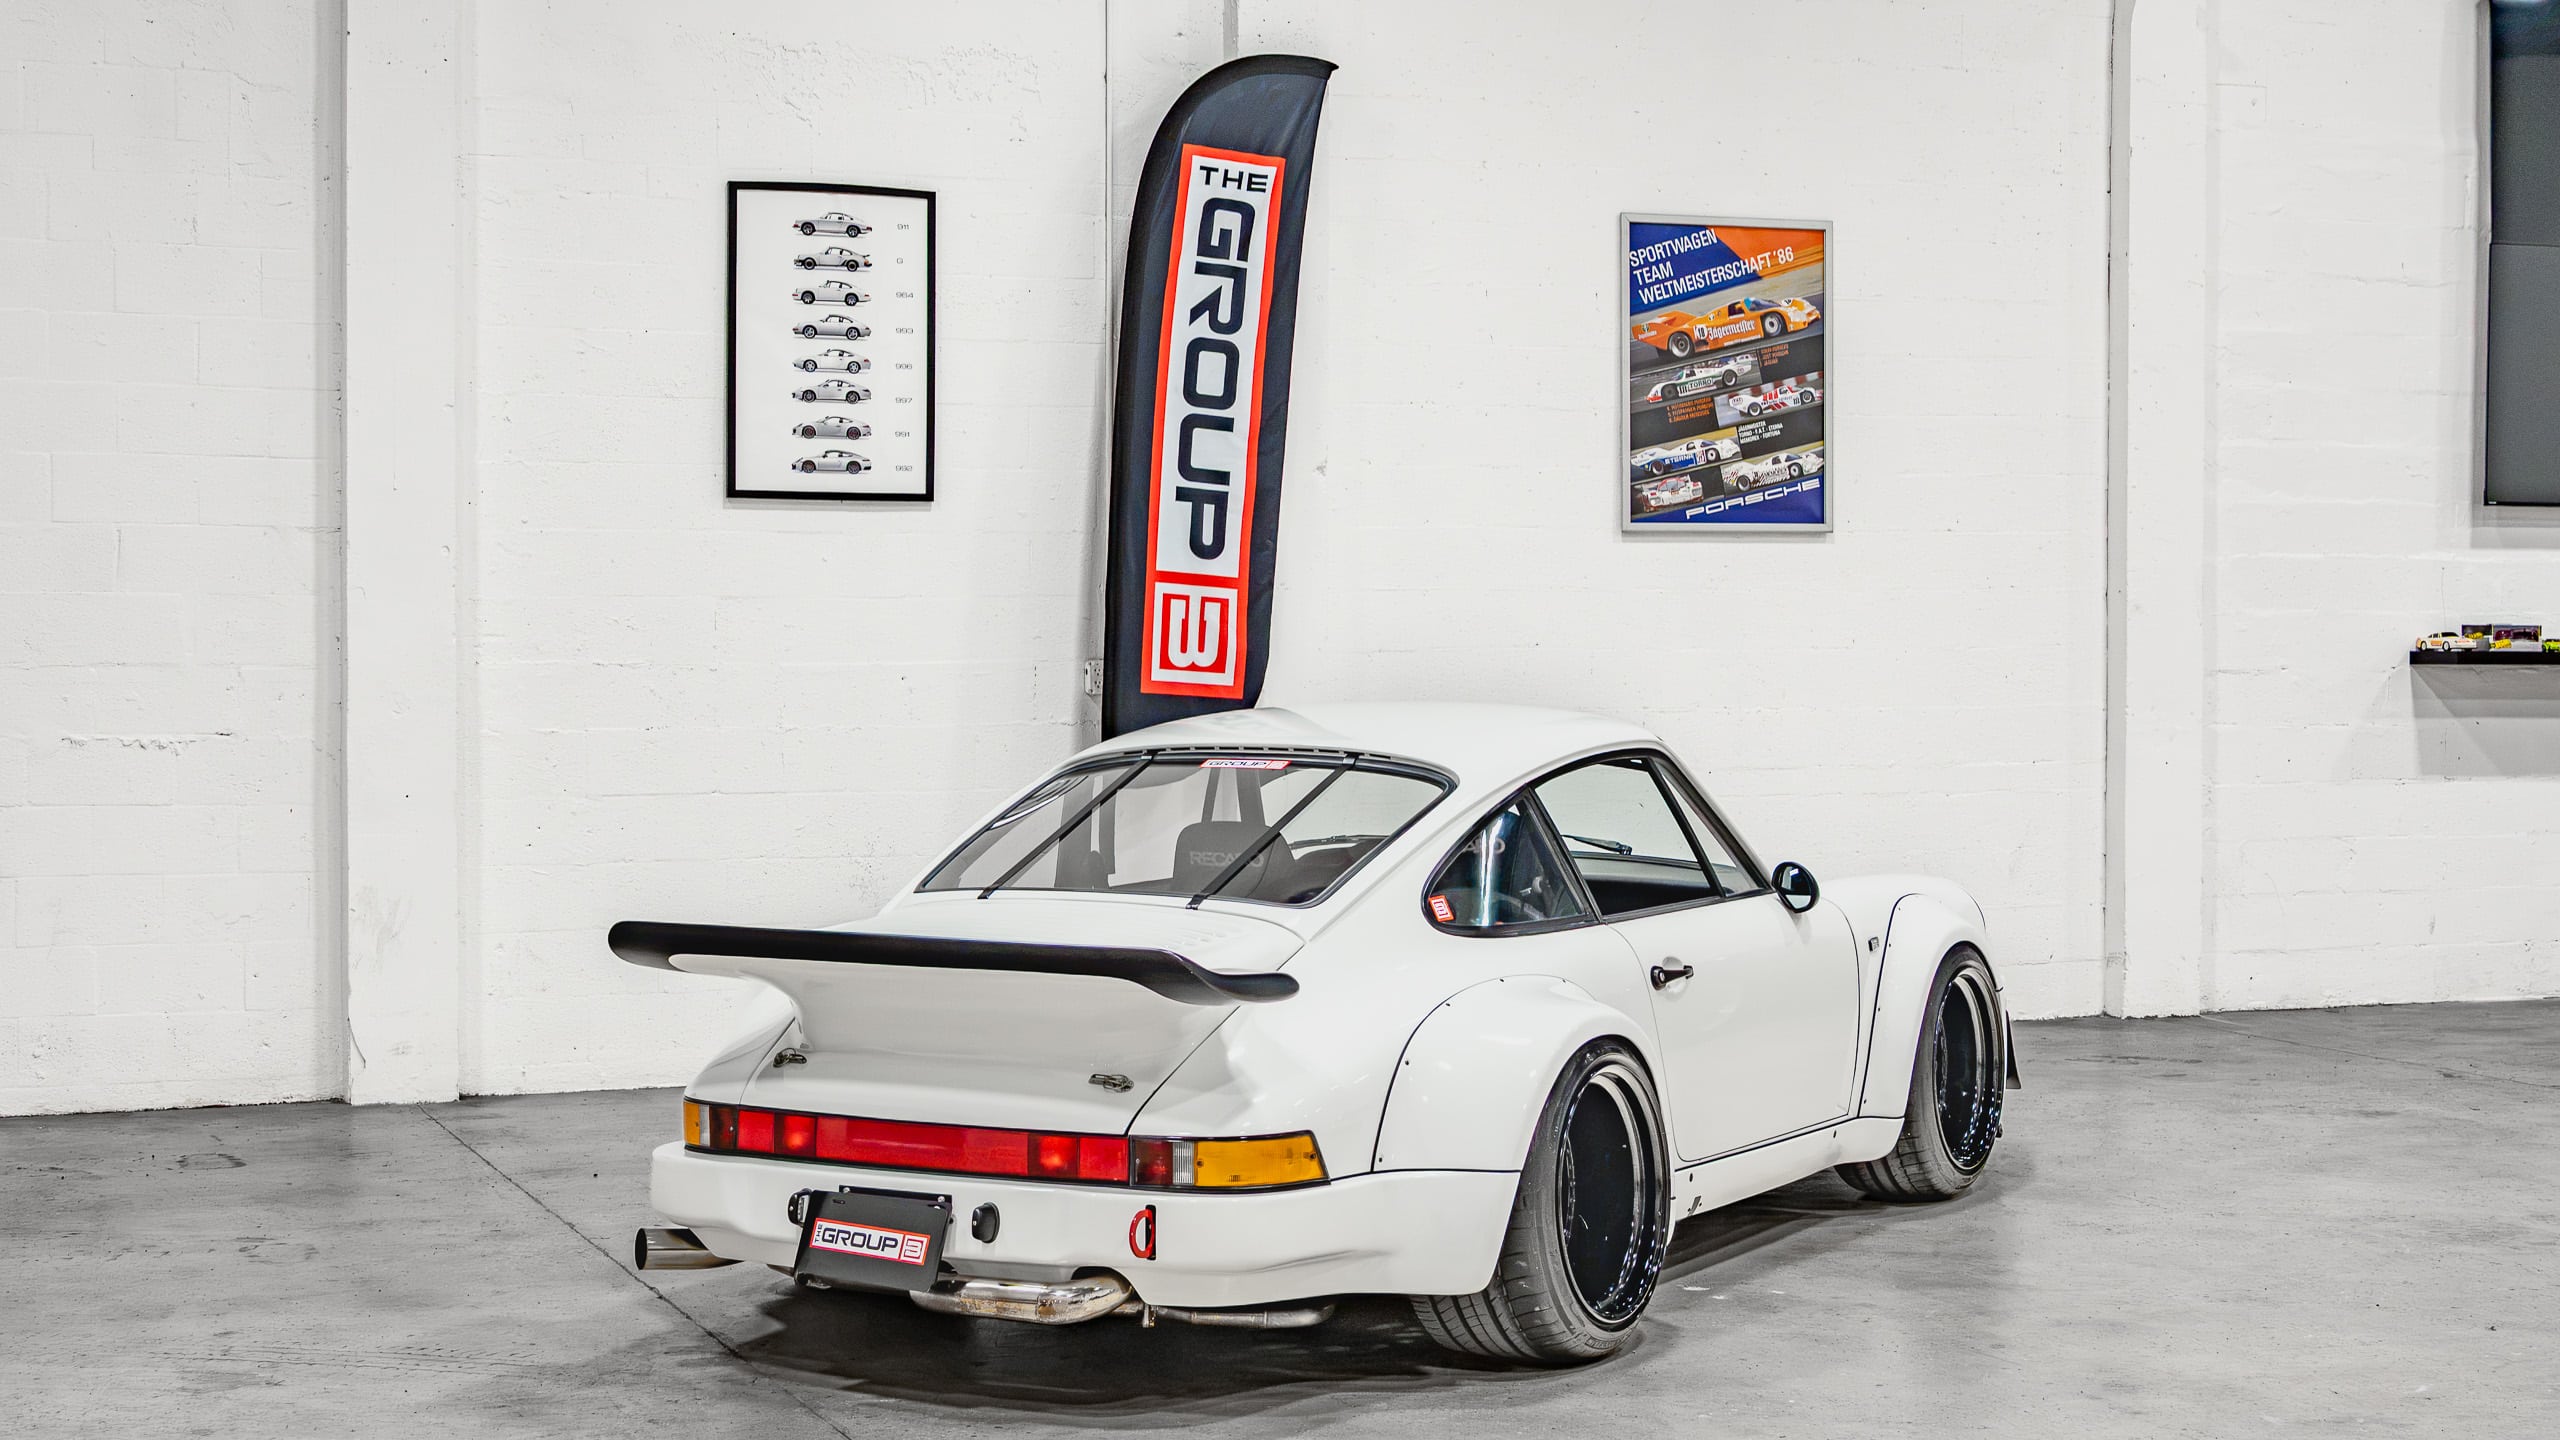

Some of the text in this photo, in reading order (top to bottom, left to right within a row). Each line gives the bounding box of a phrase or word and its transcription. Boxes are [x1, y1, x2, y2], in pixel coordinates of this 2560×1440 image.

[1199, 165, 1268, 193] THE
[1629, 228, 1718, 267] SPORTWAGEN
[1633, 261, 1674, 286] TEAM
[1638, 252, 1772, 305] WELTMEISTERSCHAFT
[1175, 197, 1256, 561] GROUP
[1685, 478, 1821, 520] PORSCHE
[1189, 850, 1265, 868] RECAO
[813, 1224, 824, 1243] THE
[821, 1227, 899, 1252] GROUP
